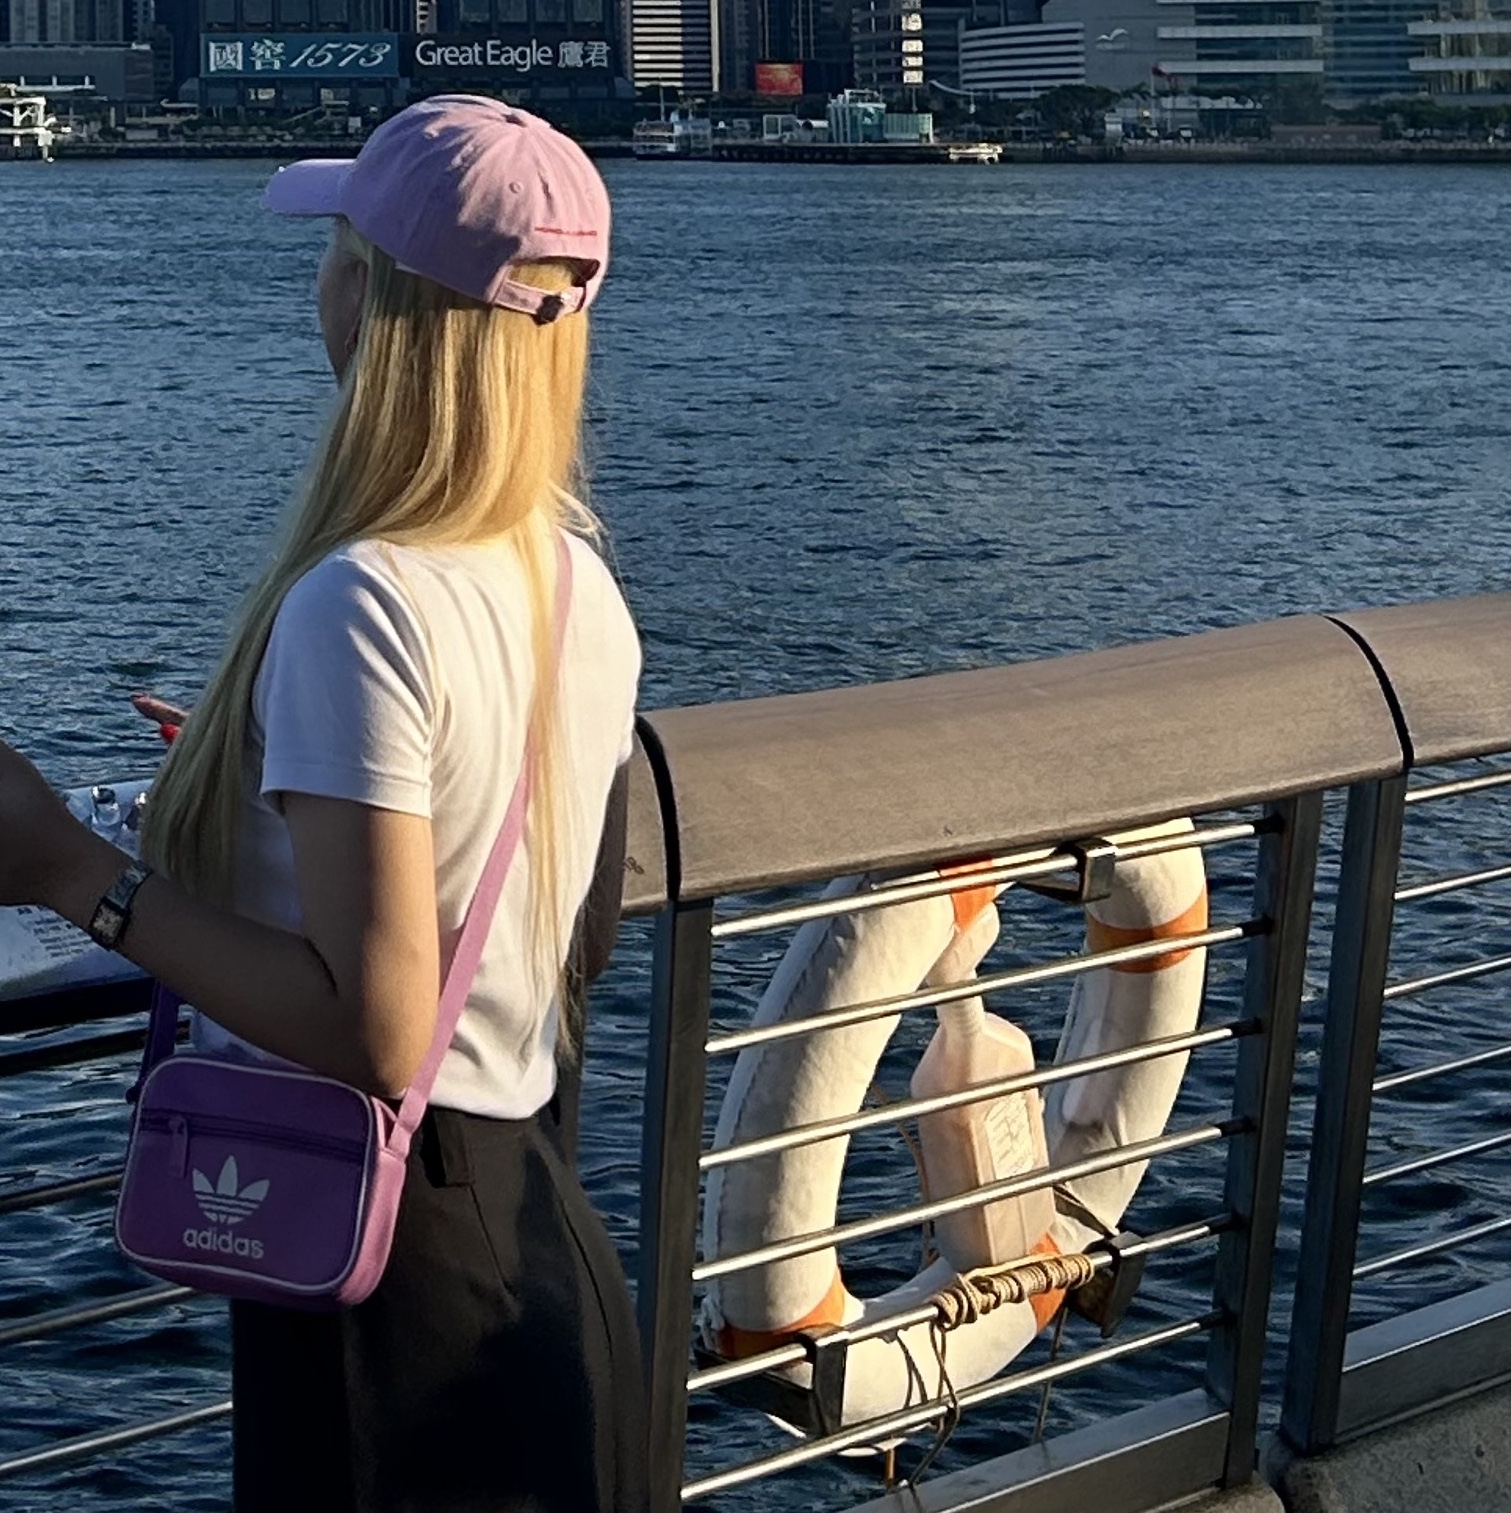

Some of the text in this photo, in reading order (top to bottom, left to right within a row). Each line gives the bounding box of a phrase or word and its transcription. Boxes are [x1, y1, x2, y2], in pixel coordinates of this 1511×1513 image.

[289, 42, 392, 68] 1573
[415, 39, 484, 66] Great
[487, 38, 554, 73] Eagle
[183, 1227, 264, 1259] adidas
